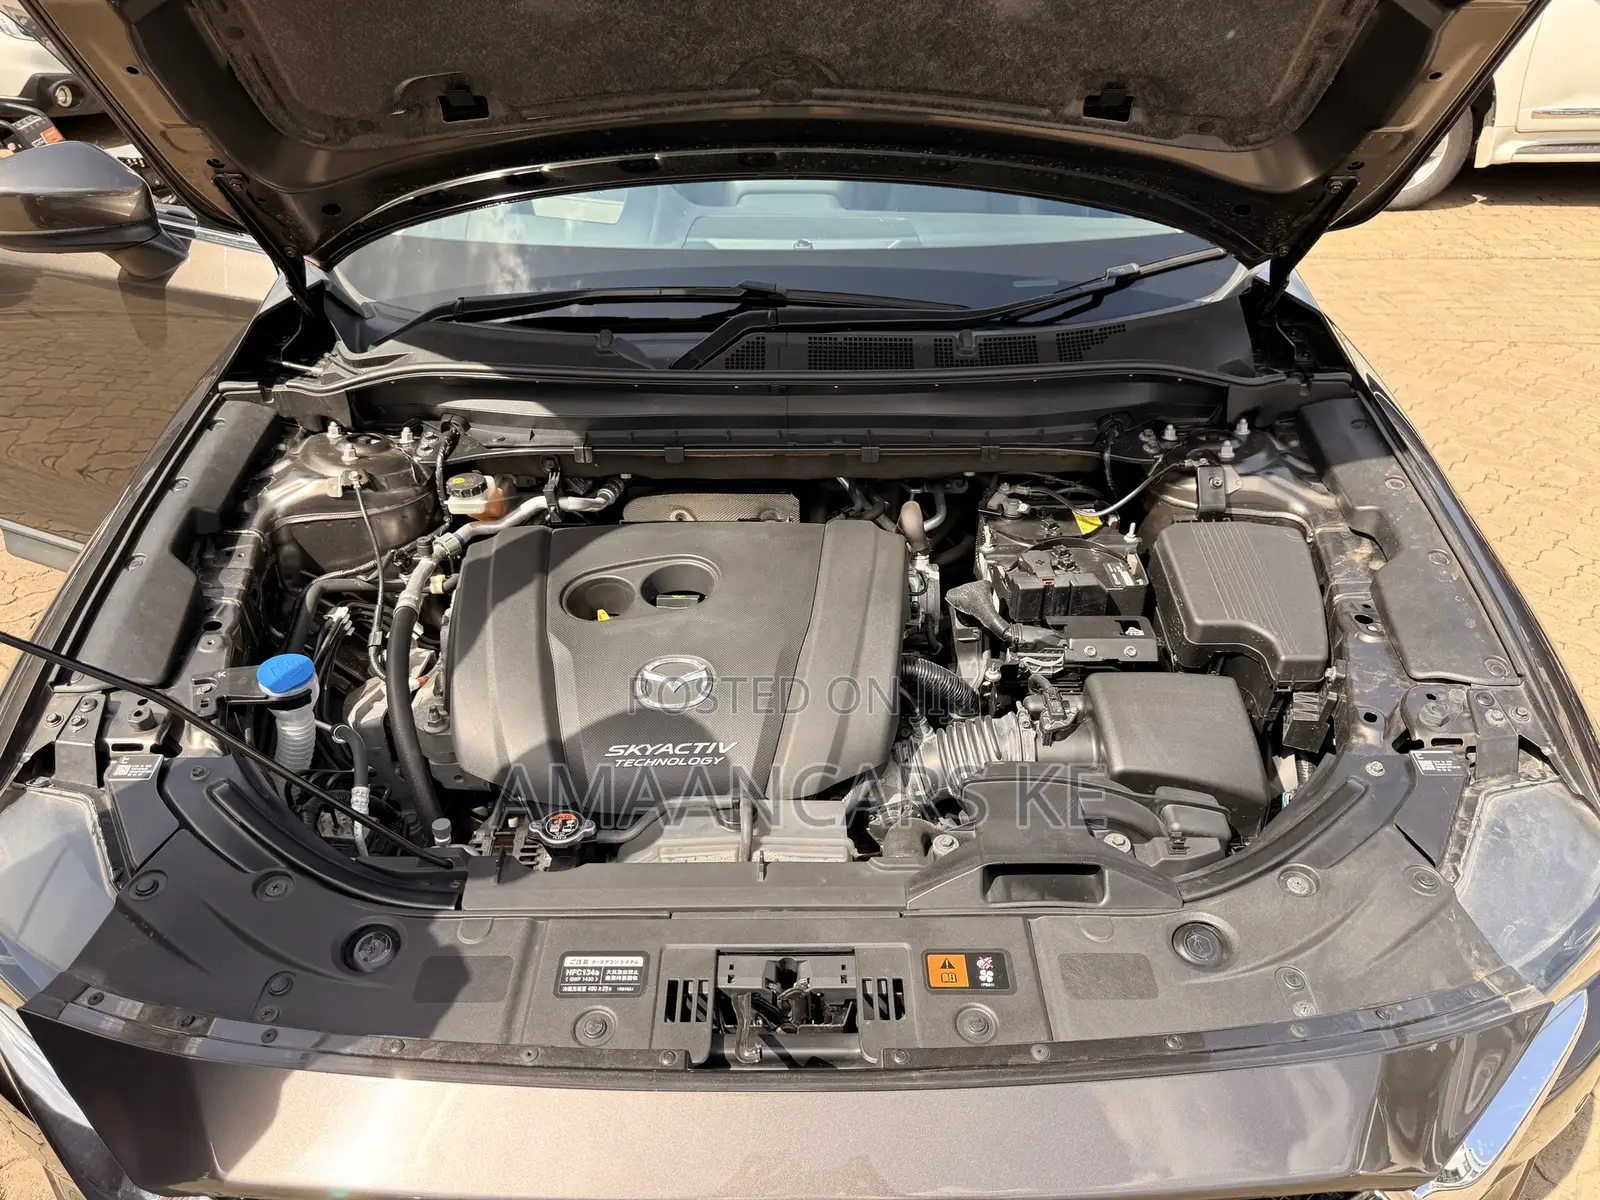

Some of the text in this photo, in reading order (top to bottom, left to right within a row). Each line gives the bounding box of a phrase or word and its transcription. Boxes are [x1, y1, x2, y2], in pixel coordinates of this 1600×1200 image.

[604, 741, 739, 757] SKYACTIV
[614, 756, 726, 768] TECHNOLOGY
[565, 968, 600, 976] HFC134a
